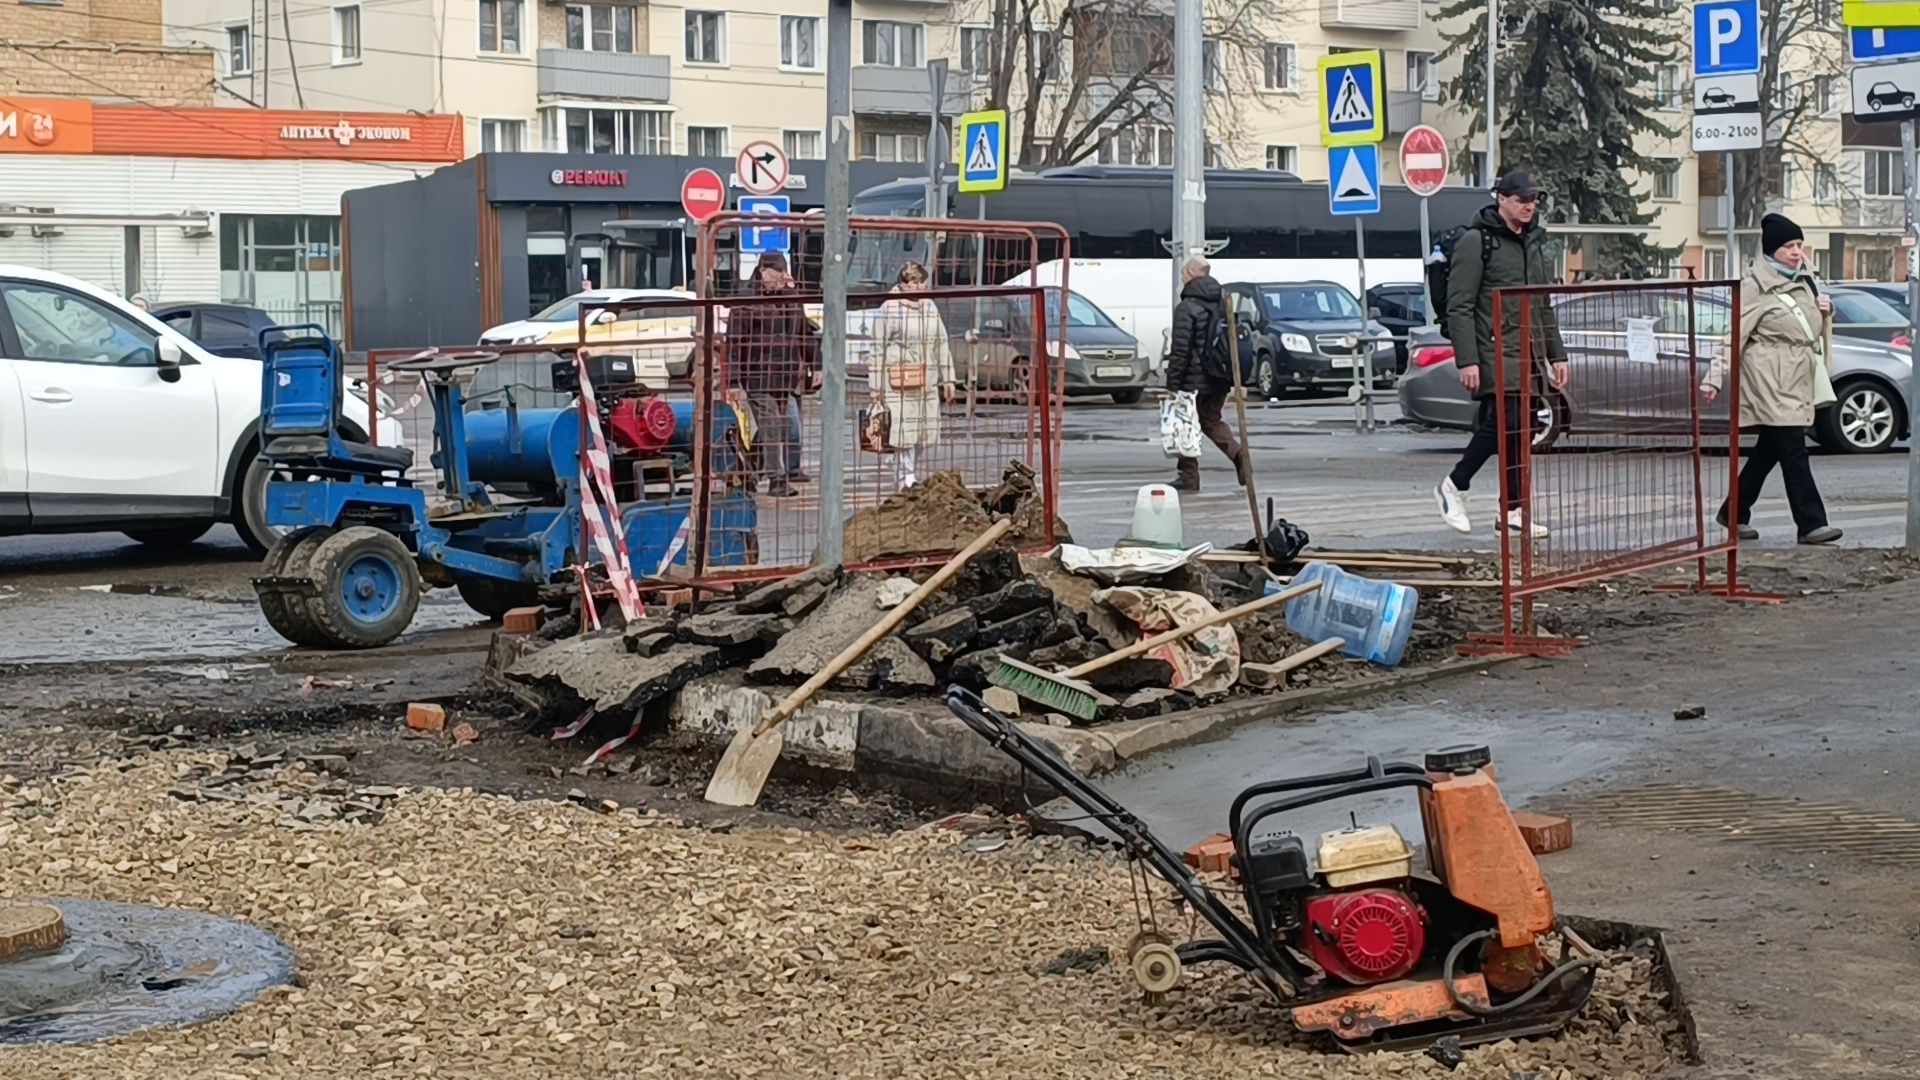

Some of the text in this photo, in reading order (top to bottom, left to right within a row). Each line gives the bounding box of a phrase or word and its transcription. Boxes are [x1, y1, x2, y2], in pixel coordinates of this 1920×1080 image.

[1709, 8, 1741, 66] P
[280, 125, 331, 139] АПТЕКА
[565, 169, 629, 186] РЕМОНТ
